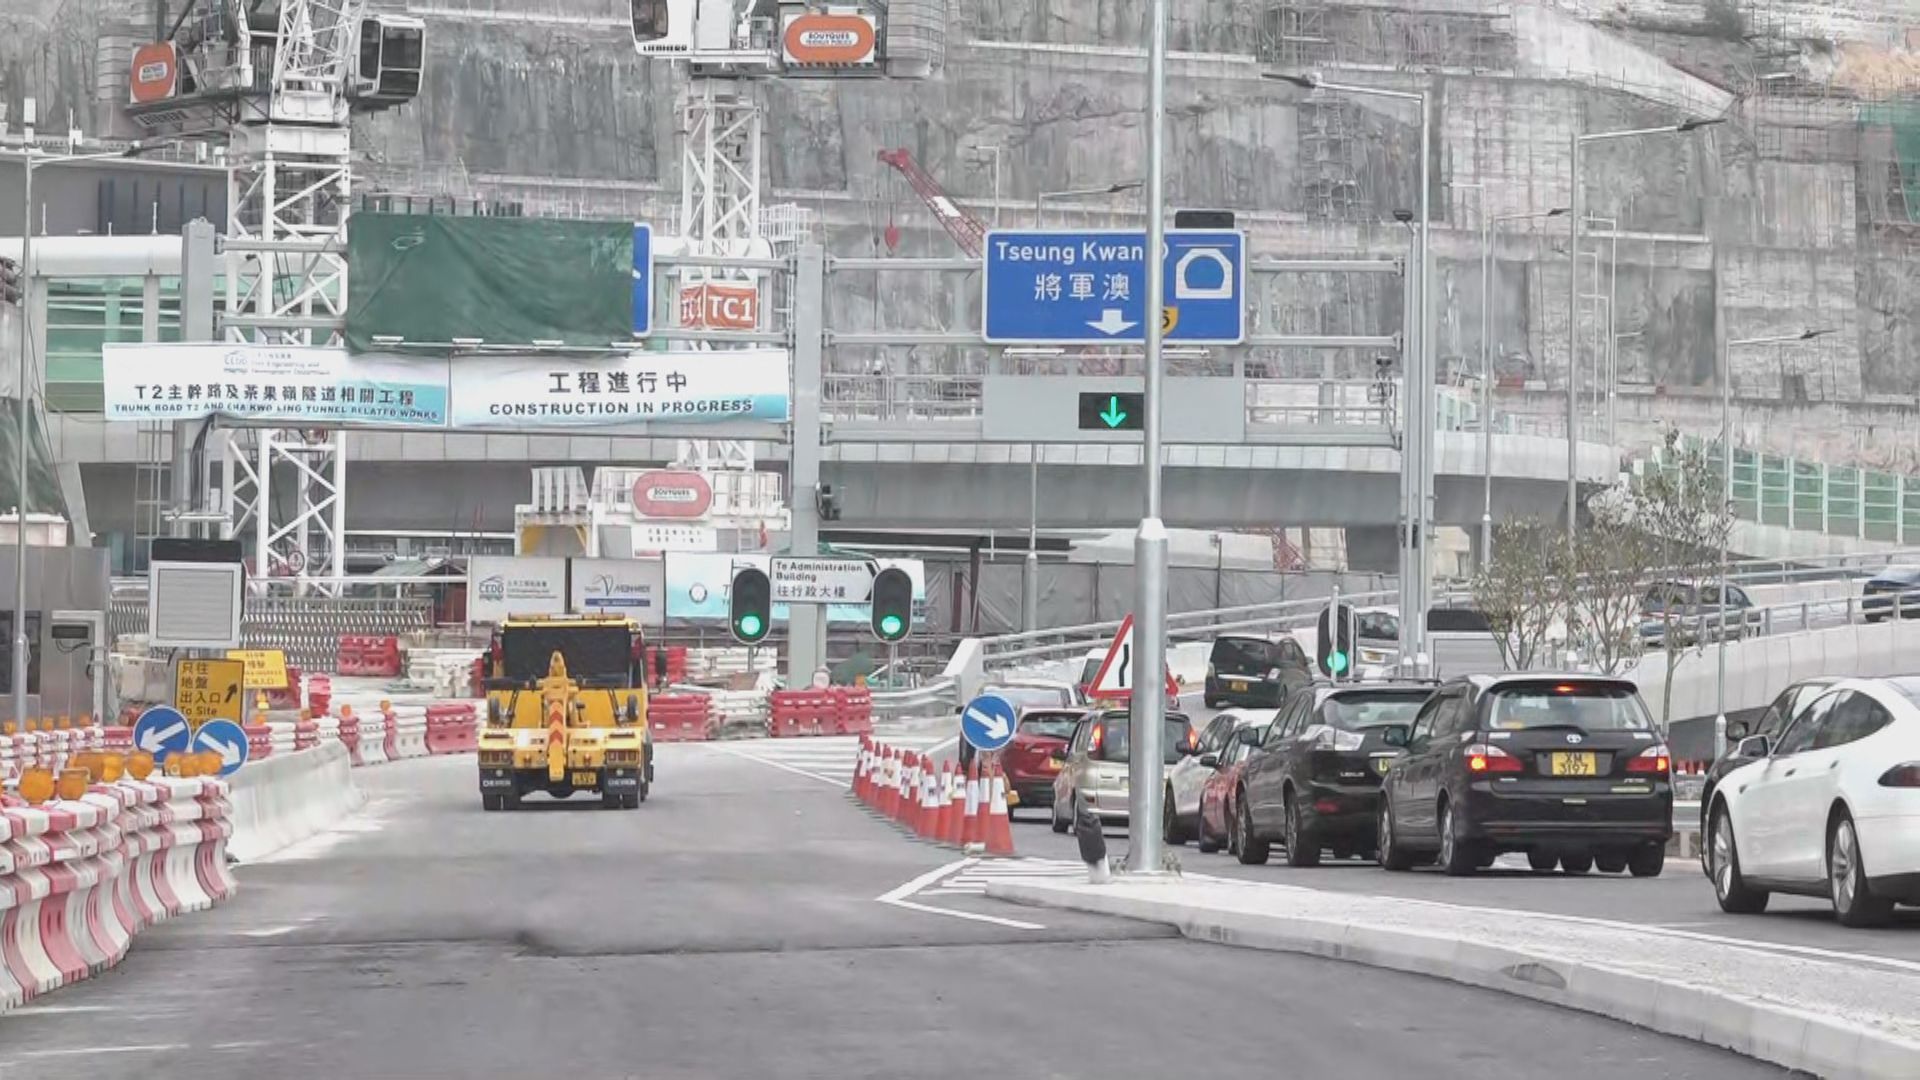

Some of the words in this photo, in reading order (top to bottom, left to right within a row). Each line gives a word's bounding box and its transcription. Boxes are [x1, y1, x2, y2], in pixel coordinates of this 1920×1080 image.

[996, 241, 1075, 265] Tseung
[1082, 241, 1144, 261] Kwan
[1034, 273, 1130, 301] 將軍澳
[708, 295, 753, 321] TC1
[549, 370, 687, 394] 工程進行中
[114, 403, 151, 412] TRUNK
[155, 403, 183, 412] ROAD
[203, 401, 224, 410] AND
[277, 404, 301, 413] LING
[306, 405, 347, 414] TUNNEL
[351, 405, 396, 416] RELATED
[401, 409, 438, 419] WORKS
[489, 401, 628, 415] CONSTRUCTION
[636, 401, 654, 414] IN
[661, 398, 753, 414] PROGRESS
[776, 561, 788, 570] To
[790, 561, 863, 572] Administration
[776, 571, 817, 582] Building
[776, 585, 846, 598] 往行政大樓
[182, 662, 208, 675] 只往
[181, 676, 208, 689] 地盤
[180, 692, 221, 703] 出入口
[196, 706, 218, 715] Site
